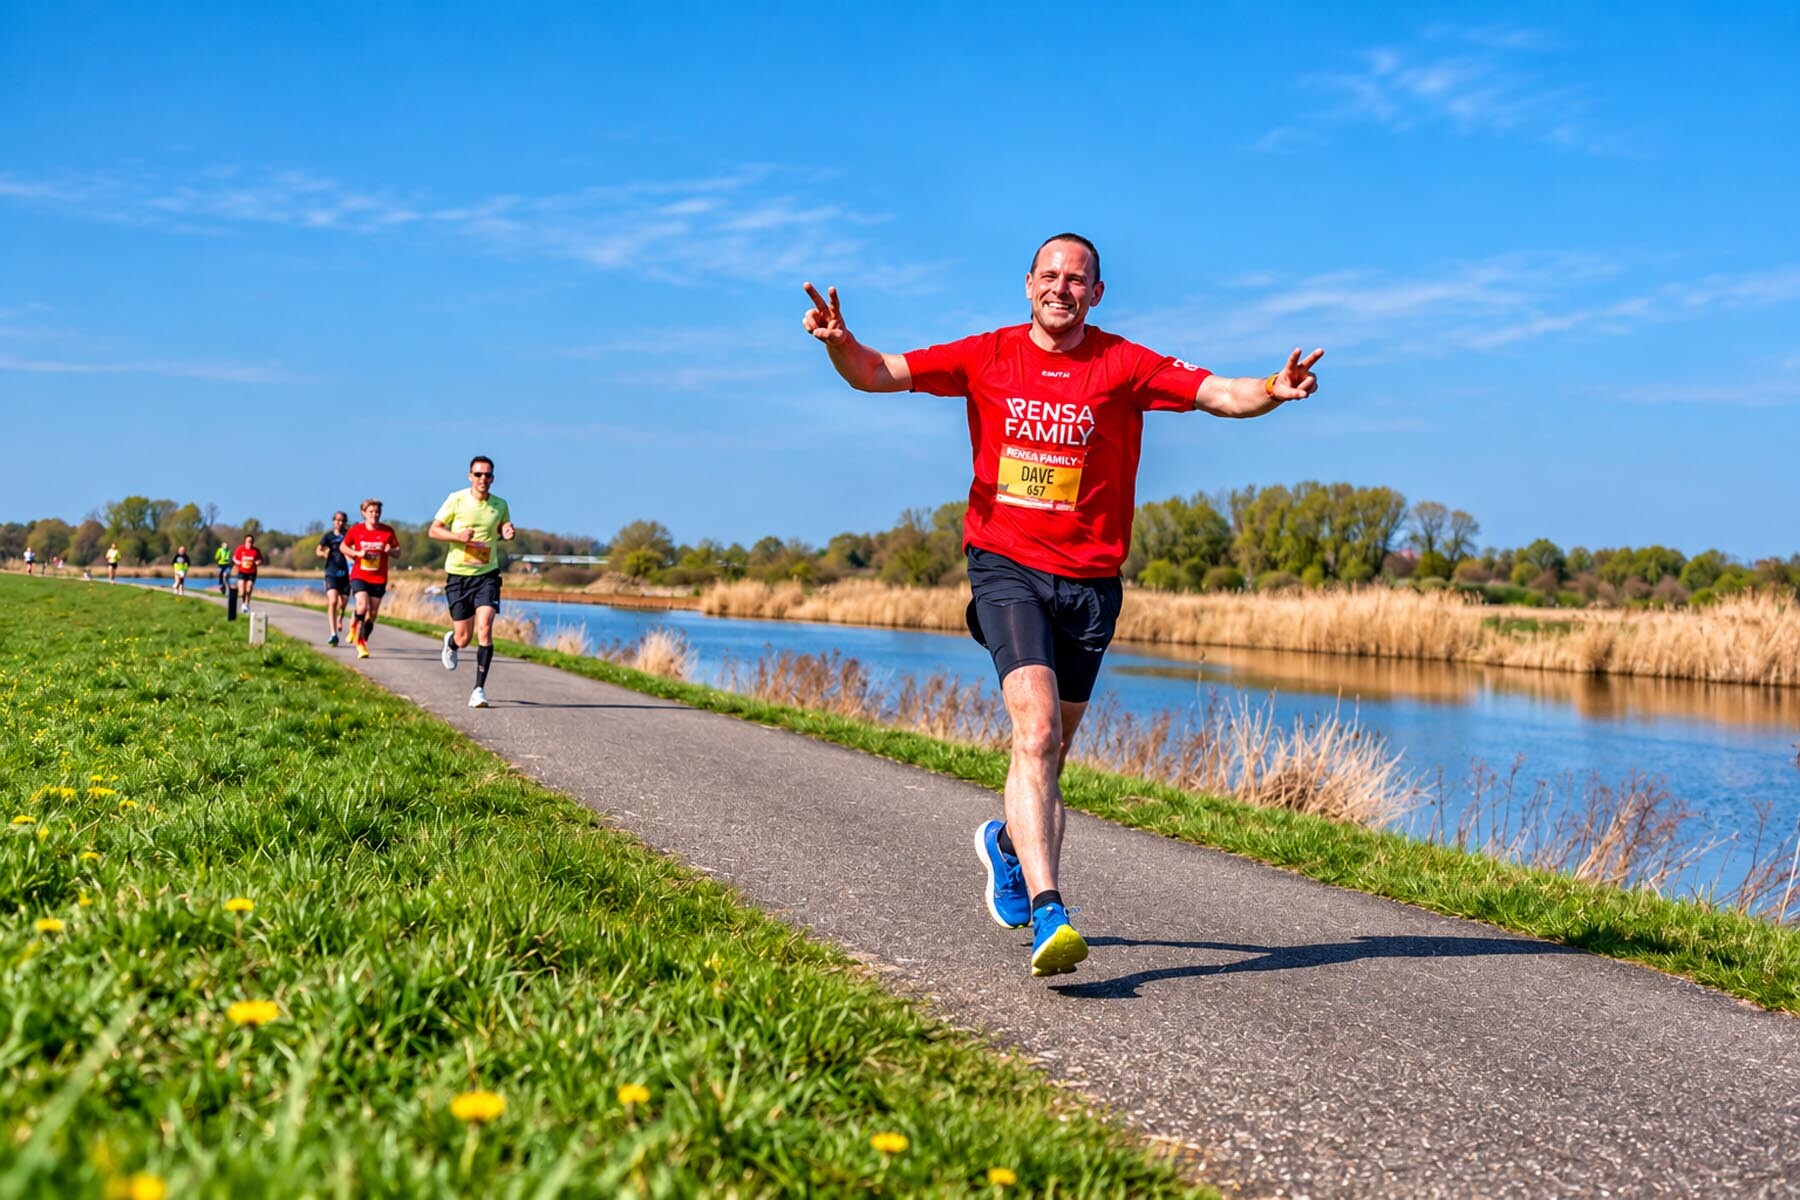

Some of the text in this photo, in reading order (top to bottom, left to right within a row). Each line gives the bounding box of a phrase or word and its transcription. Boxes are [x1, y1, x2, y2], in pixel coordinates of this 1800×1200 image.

[1006, 398, 1095, 425] RENSA
[1005, 418, 1095, 446] FAMILY
[1040, 453, 1078, 466] FAMILY
[1021, 465, 1055, 485] DAVE
[1027, 485, 1046, 496] 657
